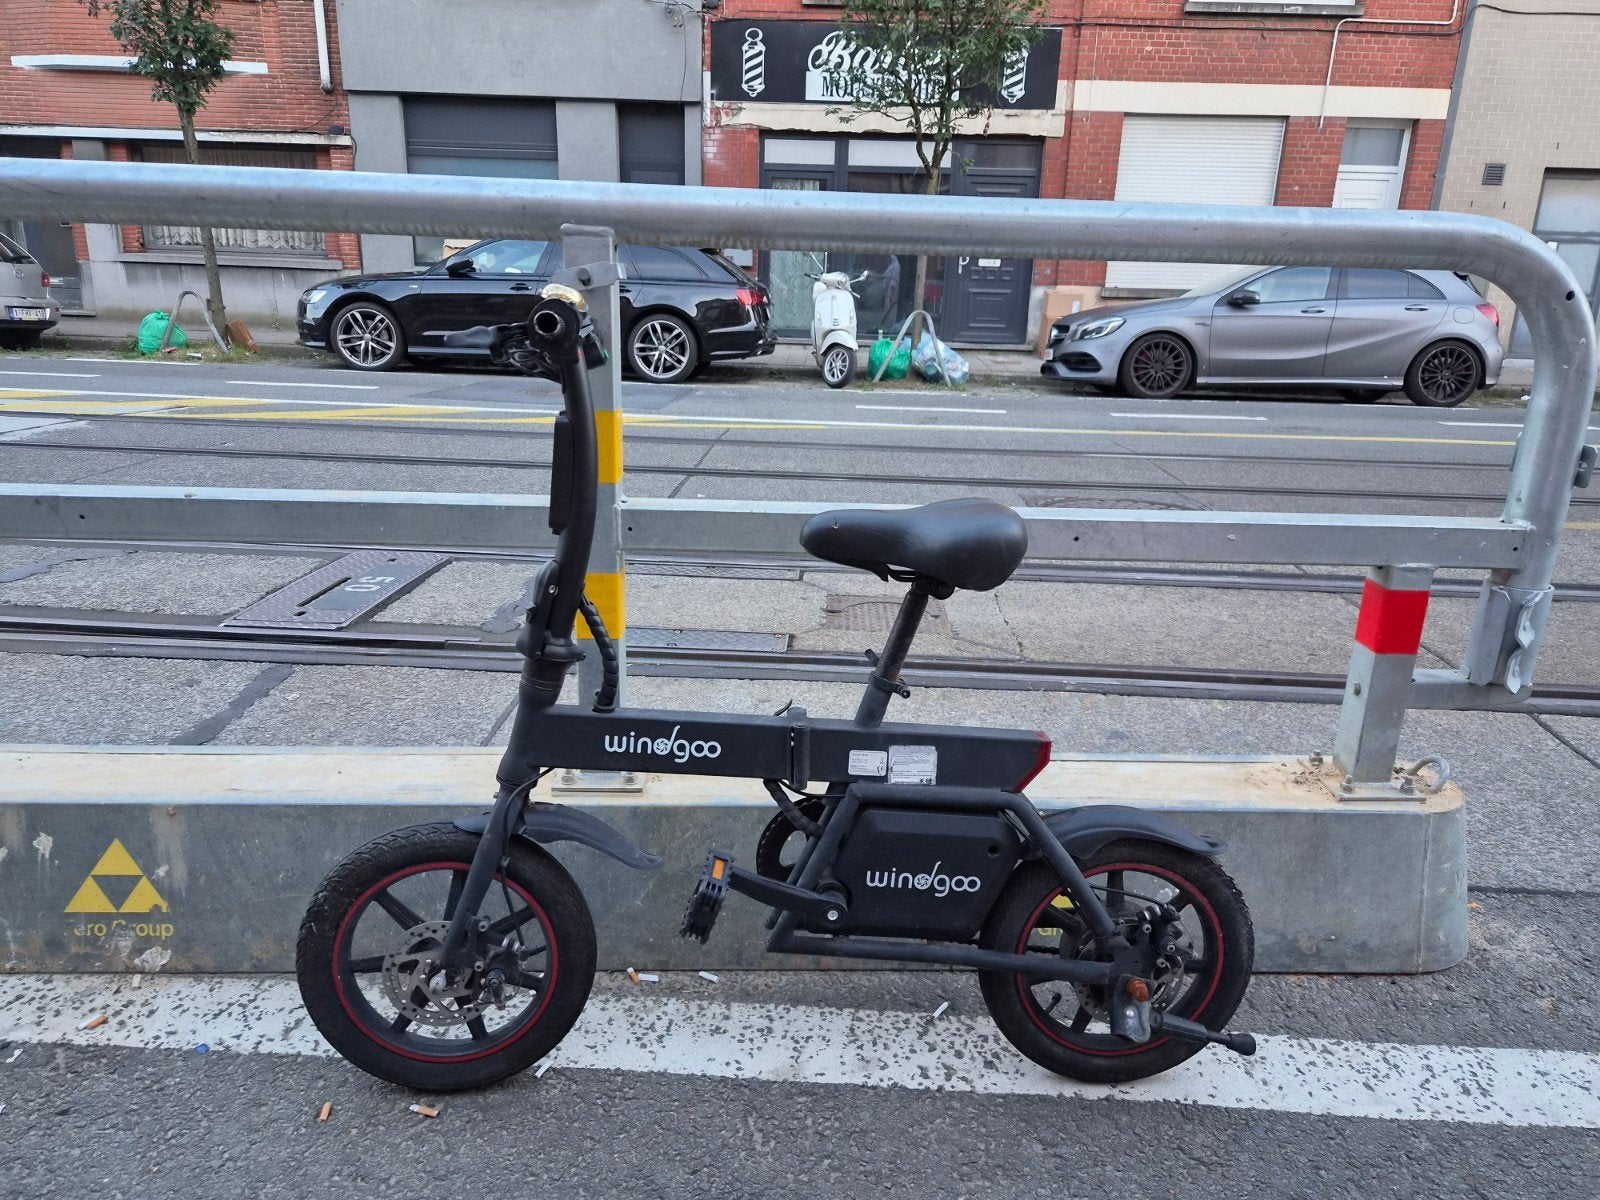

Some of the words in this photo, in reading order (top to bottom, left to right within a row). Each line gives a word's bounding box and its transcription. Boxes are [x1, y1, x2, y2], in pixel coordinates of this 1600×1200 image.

[604, 725, 722, 763] windgoo
[866, 860, 981, 898] windgoo
[111, 919, 174, 940] Goup
